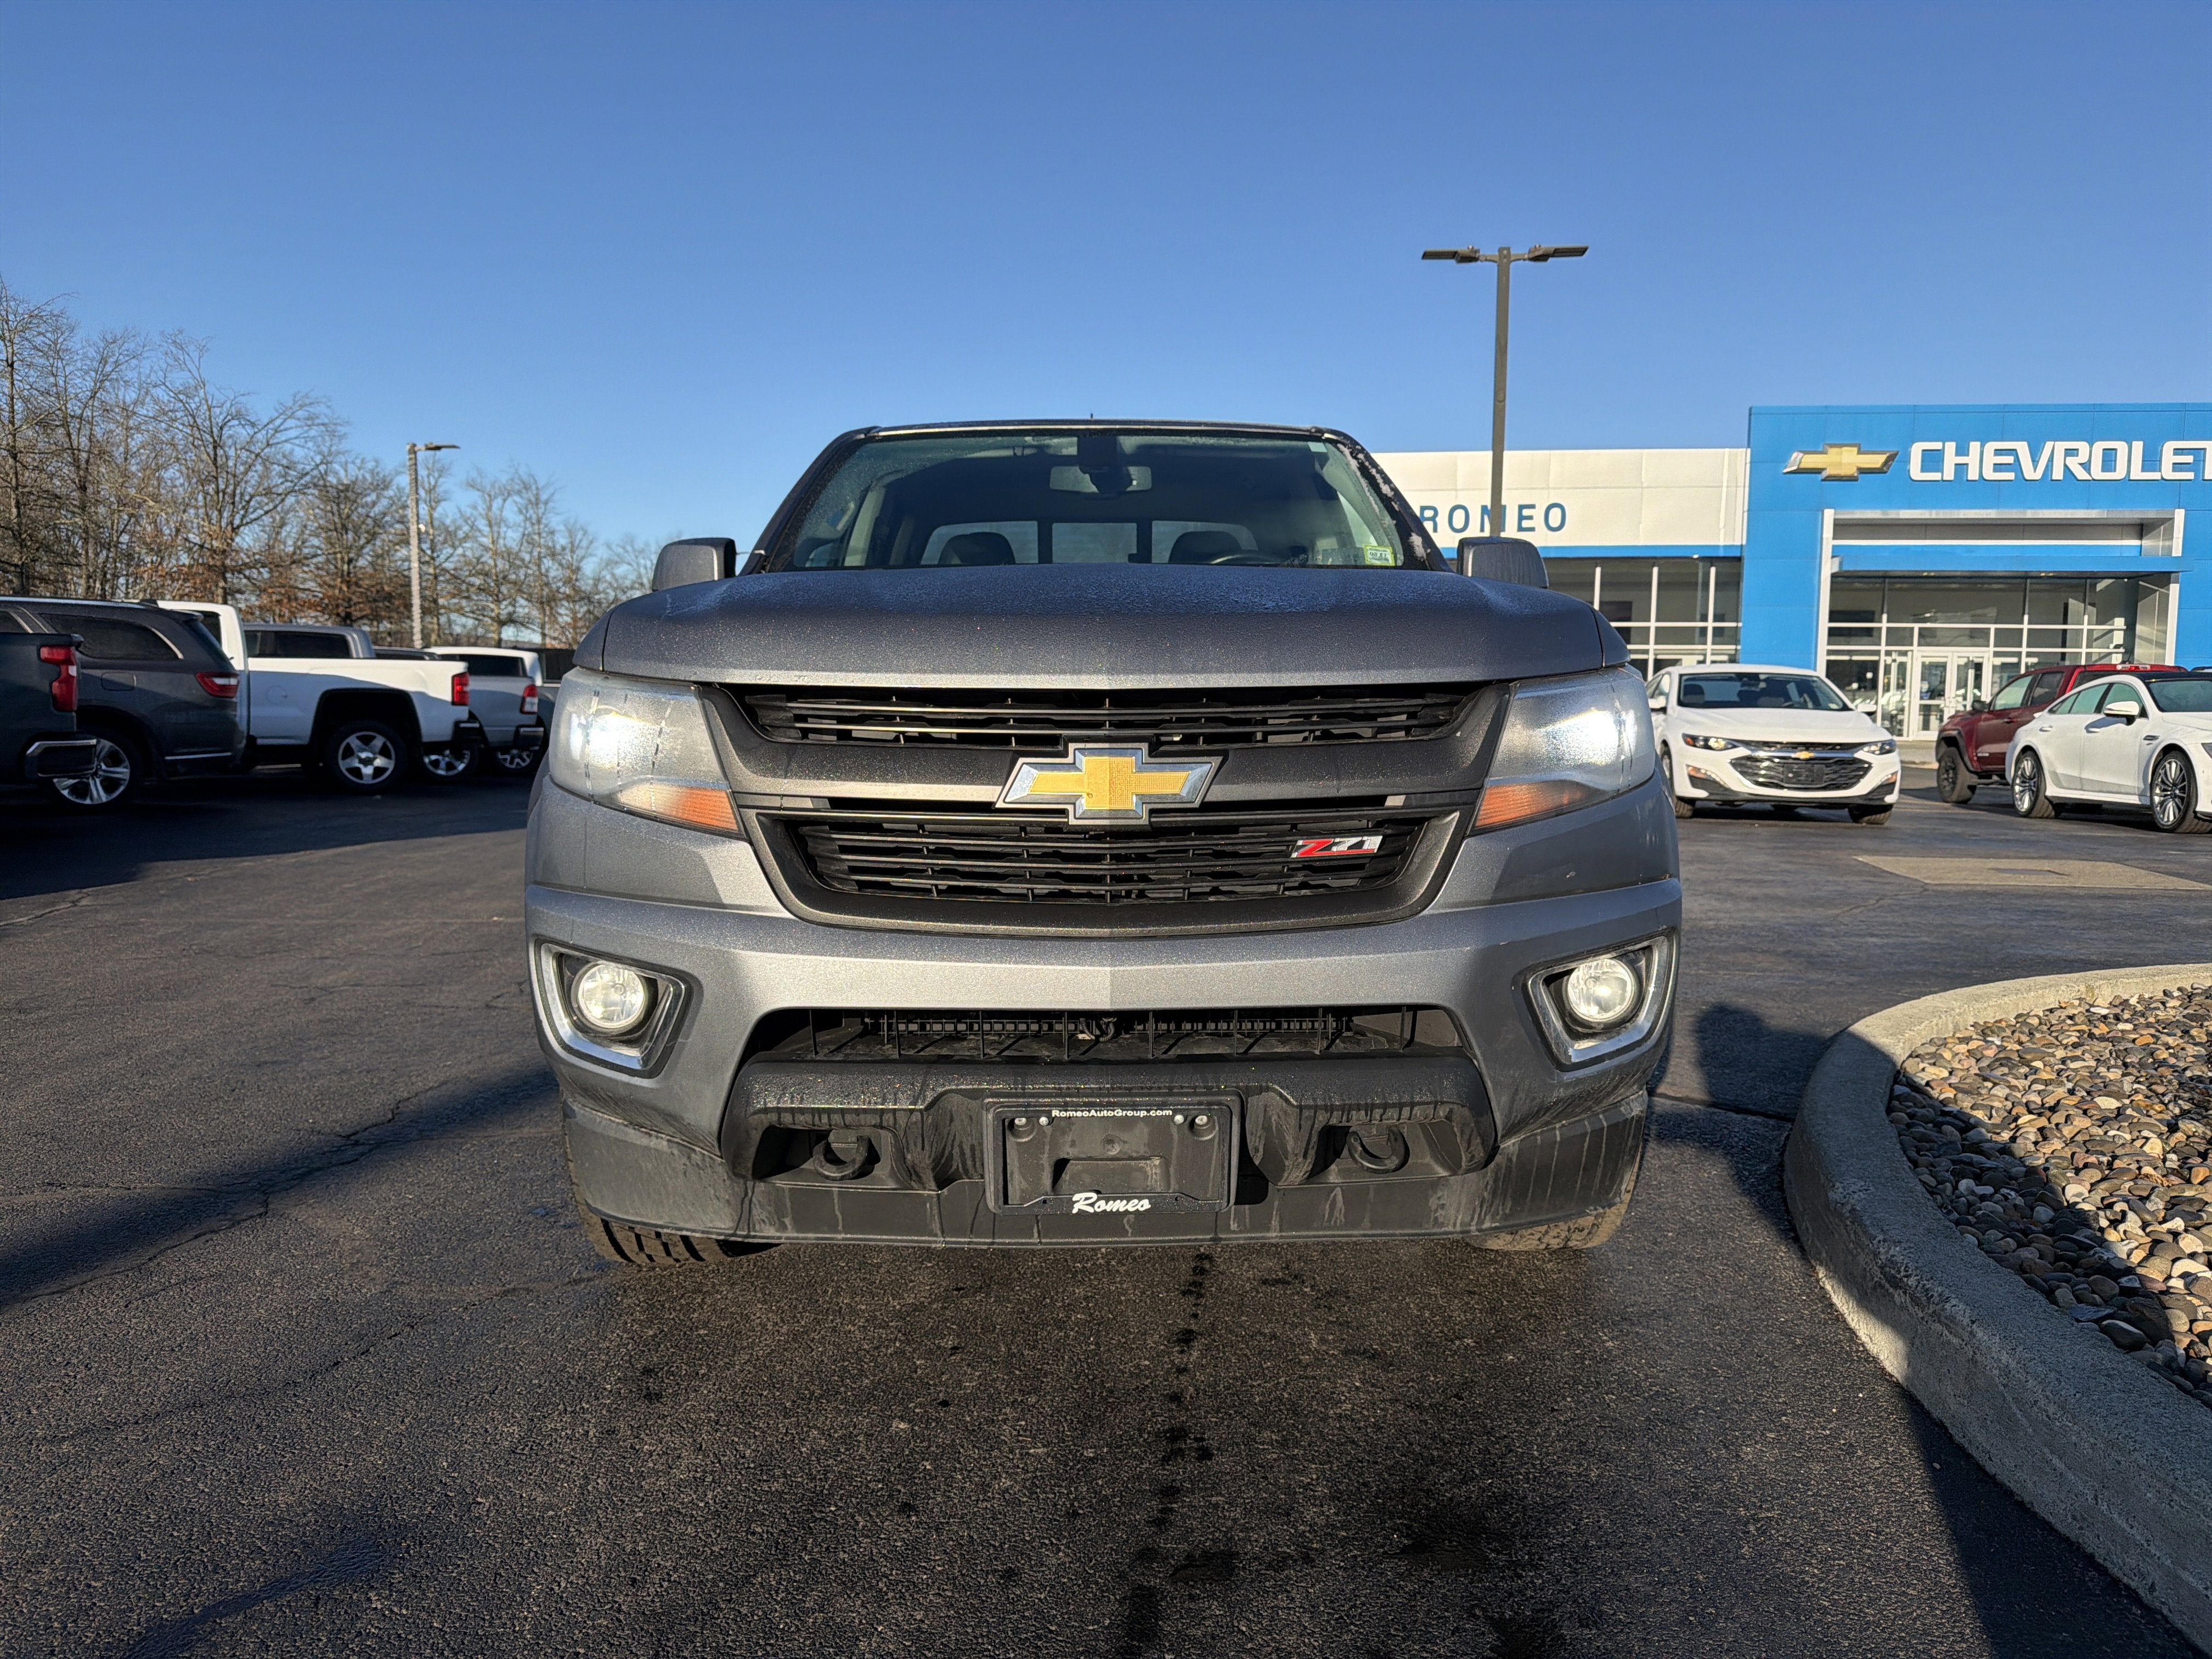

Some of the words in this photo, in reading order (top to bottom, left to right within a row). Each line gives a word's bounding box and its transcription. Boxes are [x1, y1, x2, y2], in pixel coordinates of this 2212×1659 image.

[1419, 503, 1566, 533] ROMEO
[1290, 836, 1383, 859] Z71
[1052, 1109, 1173, 1118] RomeoAutoGroup.com
[1071, 1192, 1152, 1214] Romeo
